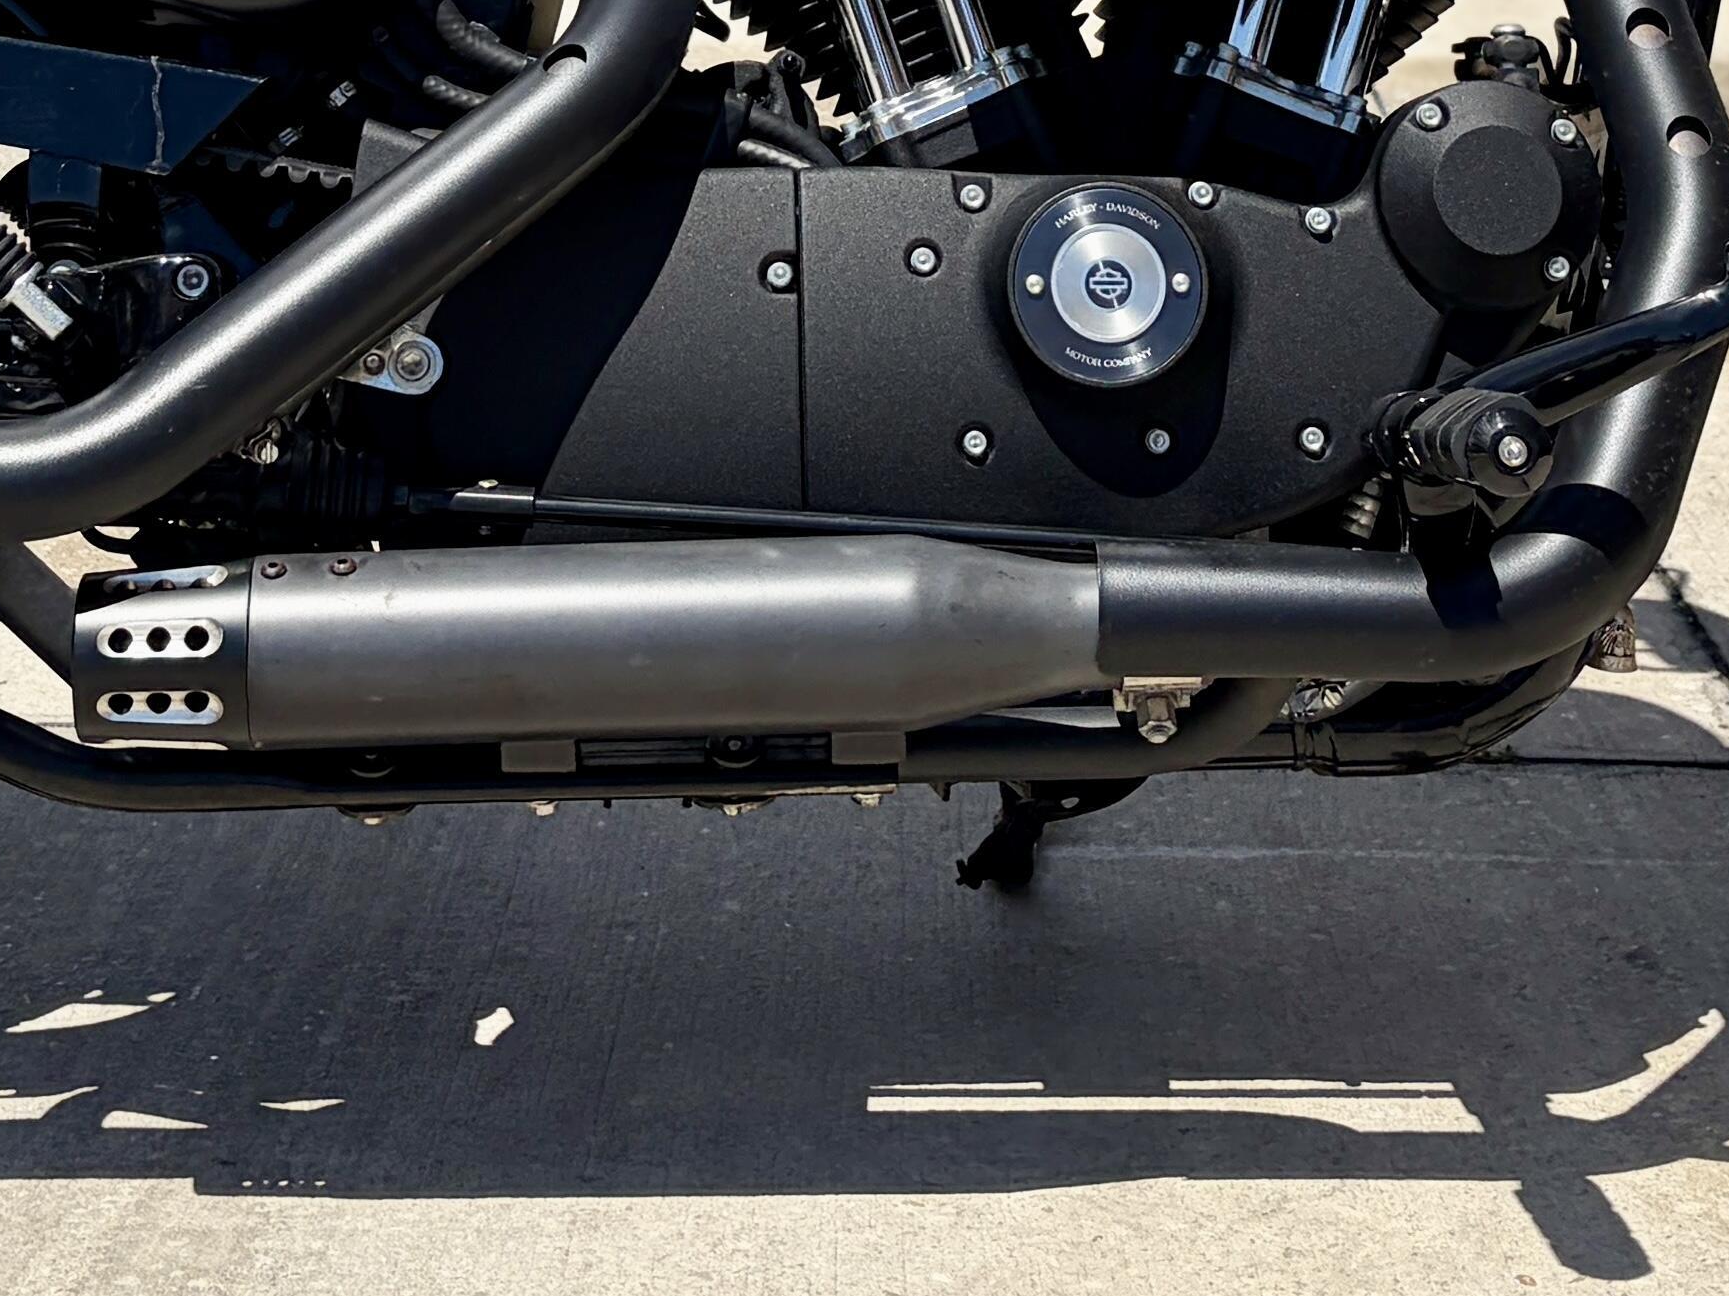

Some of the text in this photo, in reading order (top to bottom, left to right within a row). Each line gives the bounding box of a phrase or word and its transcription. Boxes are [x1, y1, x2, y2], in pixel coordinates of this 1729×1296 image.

[1054, 202, 1162, 230] HARLEY DAVIDSON
[1064, 346, 1152, 368] MOTOR COMPANY
